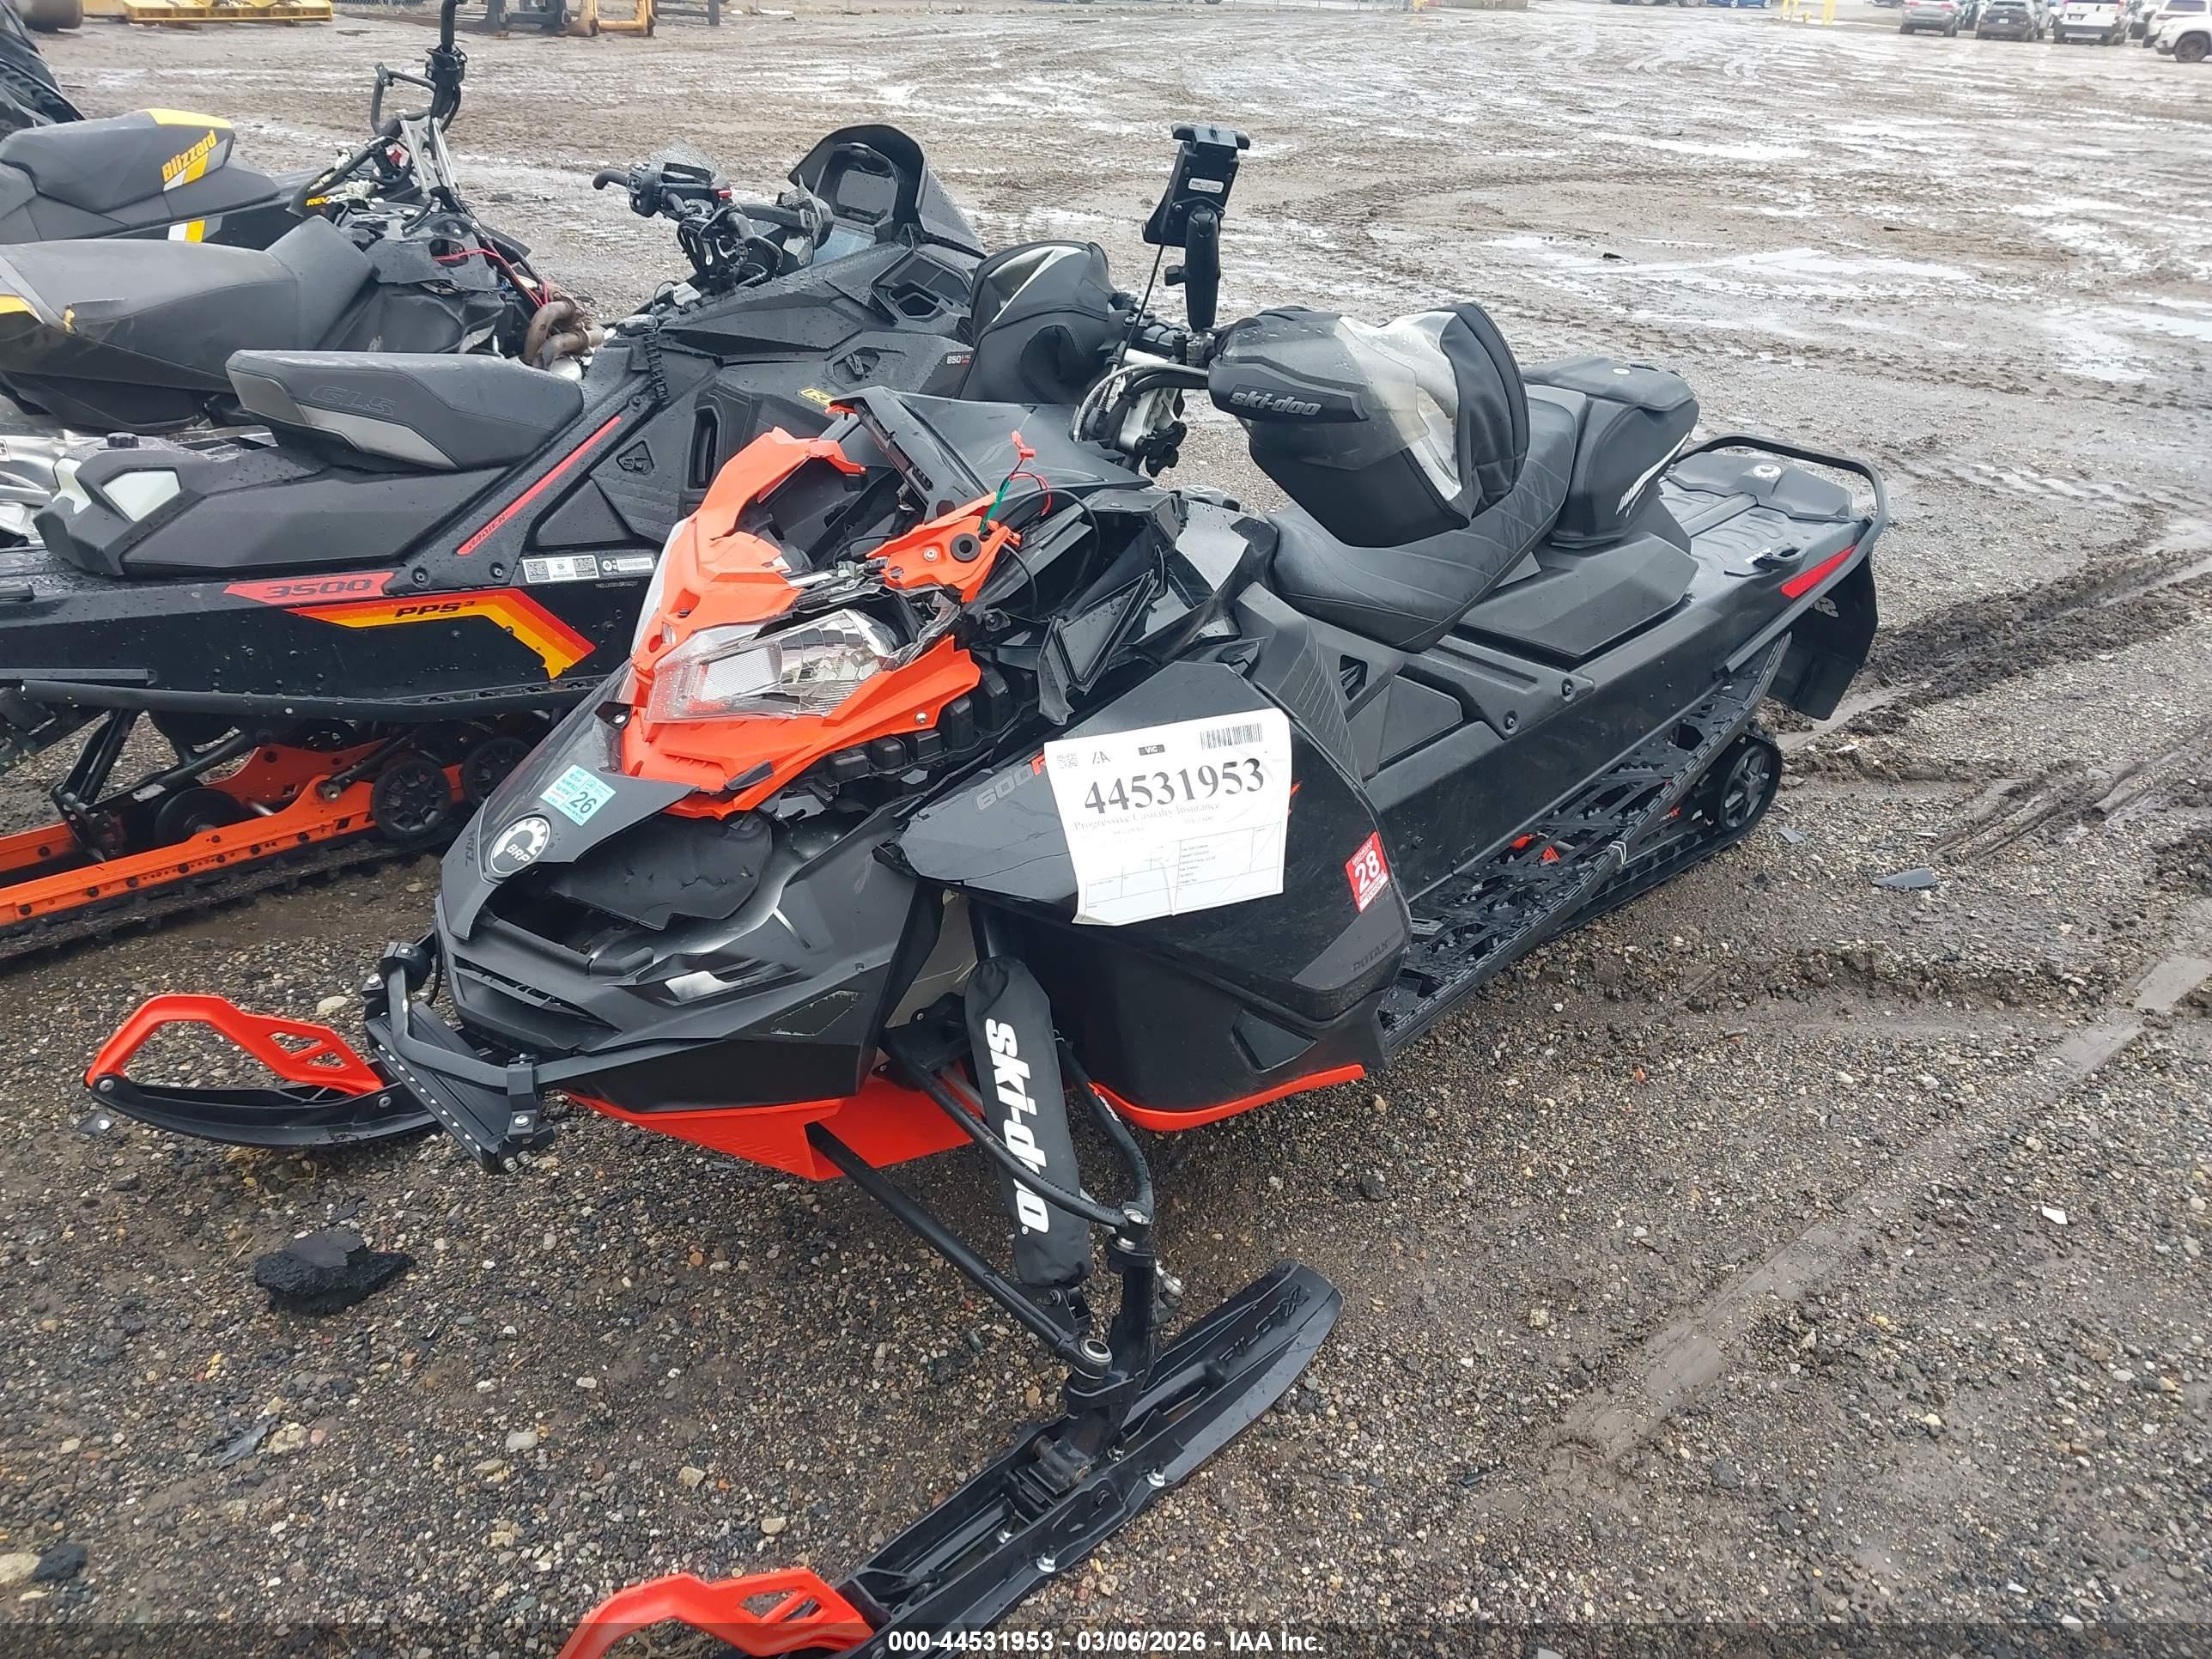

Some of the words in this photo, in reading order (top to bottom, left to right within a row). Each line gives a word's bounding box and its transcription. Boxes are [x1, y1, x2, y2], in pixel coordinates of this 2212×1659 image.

[161, 129, 218, 183] Blizzard
[946, 355, 962, 365] 850
[309, 385, 397, 416] GLS
[1229, 391, 1322, 416] ski-doo
[263, 579, 372, 599] 3500
[1144, 745, 1159, 754] VIC
[1085, 758, 1264, 814] 44531953
[569, 791, 597, 813] 26
[1073, 816, 1131, 831] Progressive
[1133, 810, 1174, 822] Casualty
[1176, 802, 1221, 815] Insurance
[506, 843, 531, 862] BRP
[1354, 850, 1380, 894] 28
